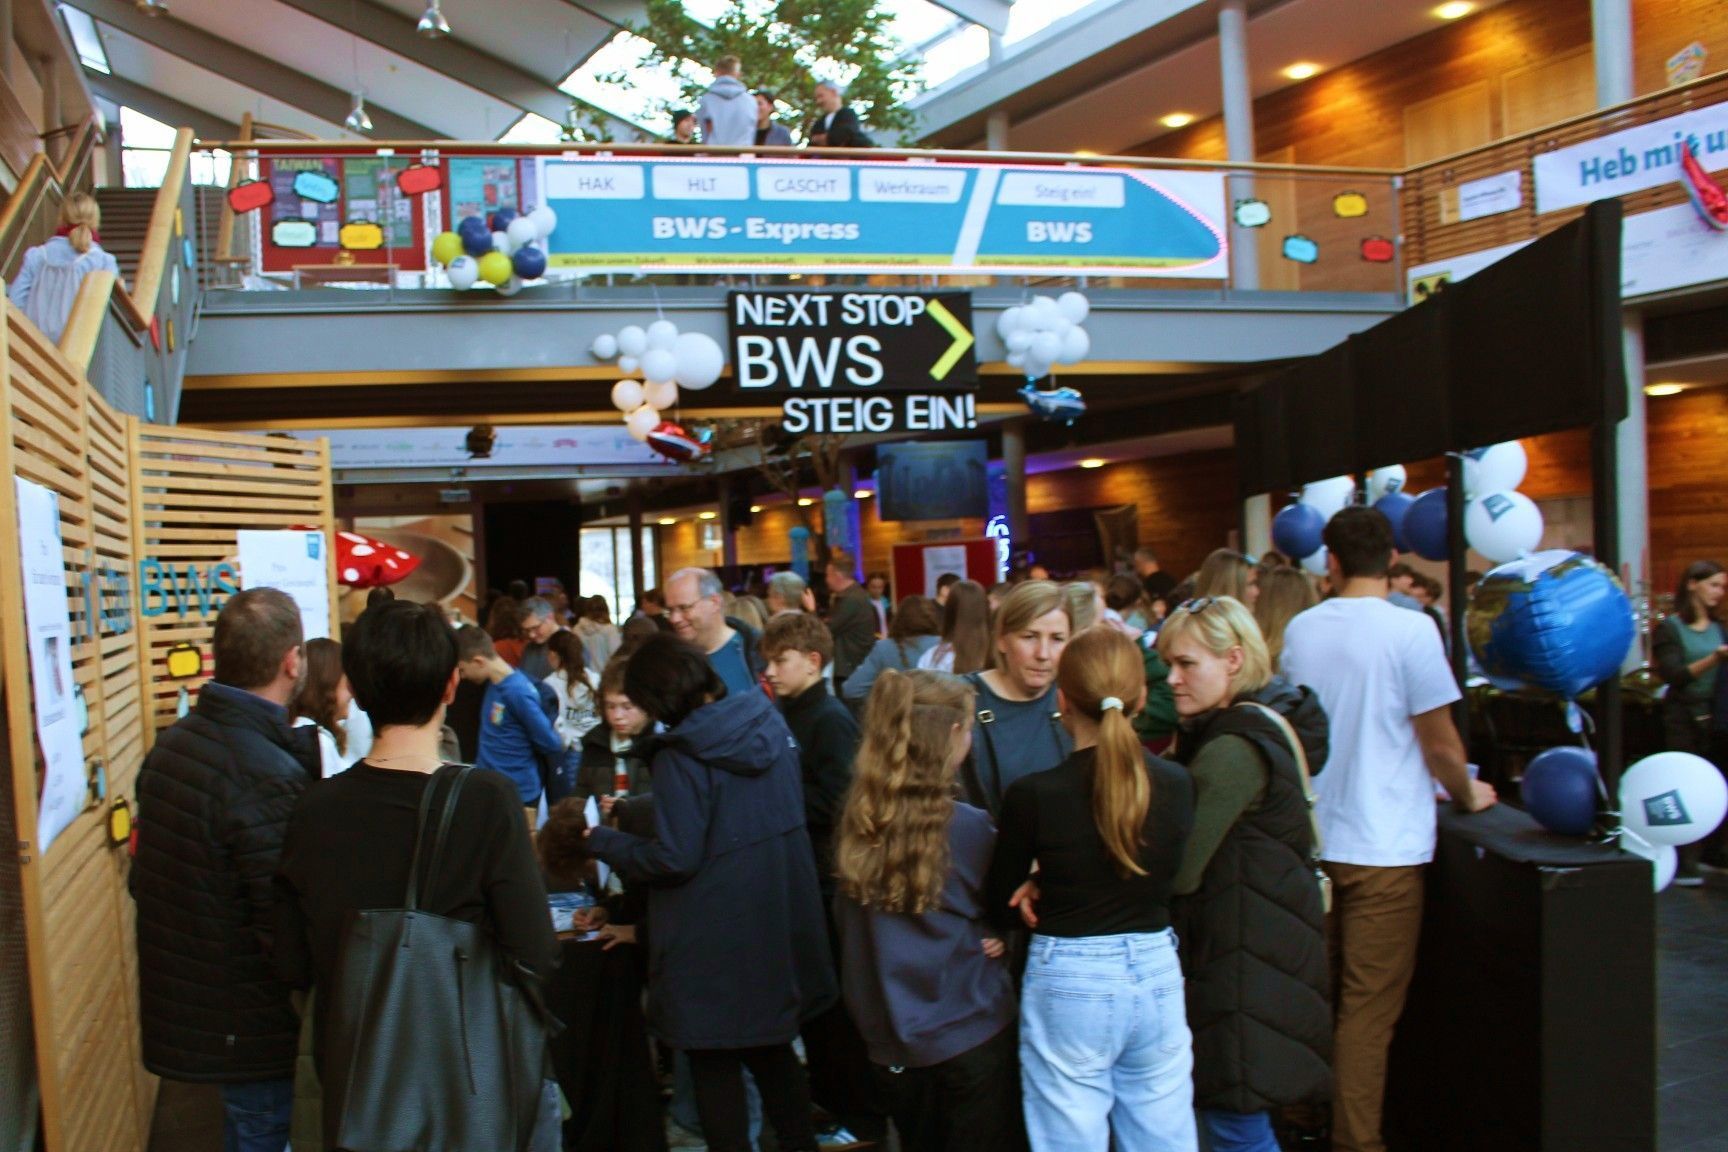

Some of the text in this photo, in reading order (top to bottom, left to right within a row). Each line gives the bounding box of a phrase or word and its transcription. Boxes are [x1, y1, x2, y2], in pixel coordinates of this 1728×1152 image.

[578, 176, 615, 191] HAK
[687, 177, 718, 192] HLT
[1579, 146, 1637, 187] Heb
[1026, 220, 1093, 243] BWS
[736, 293, 926, 326] NEXT STOP
[736, 334, 884, 388] BWS
[783, 393, 978, 433] STEIG EIN!
[139, 556, 239, 618] BWS
